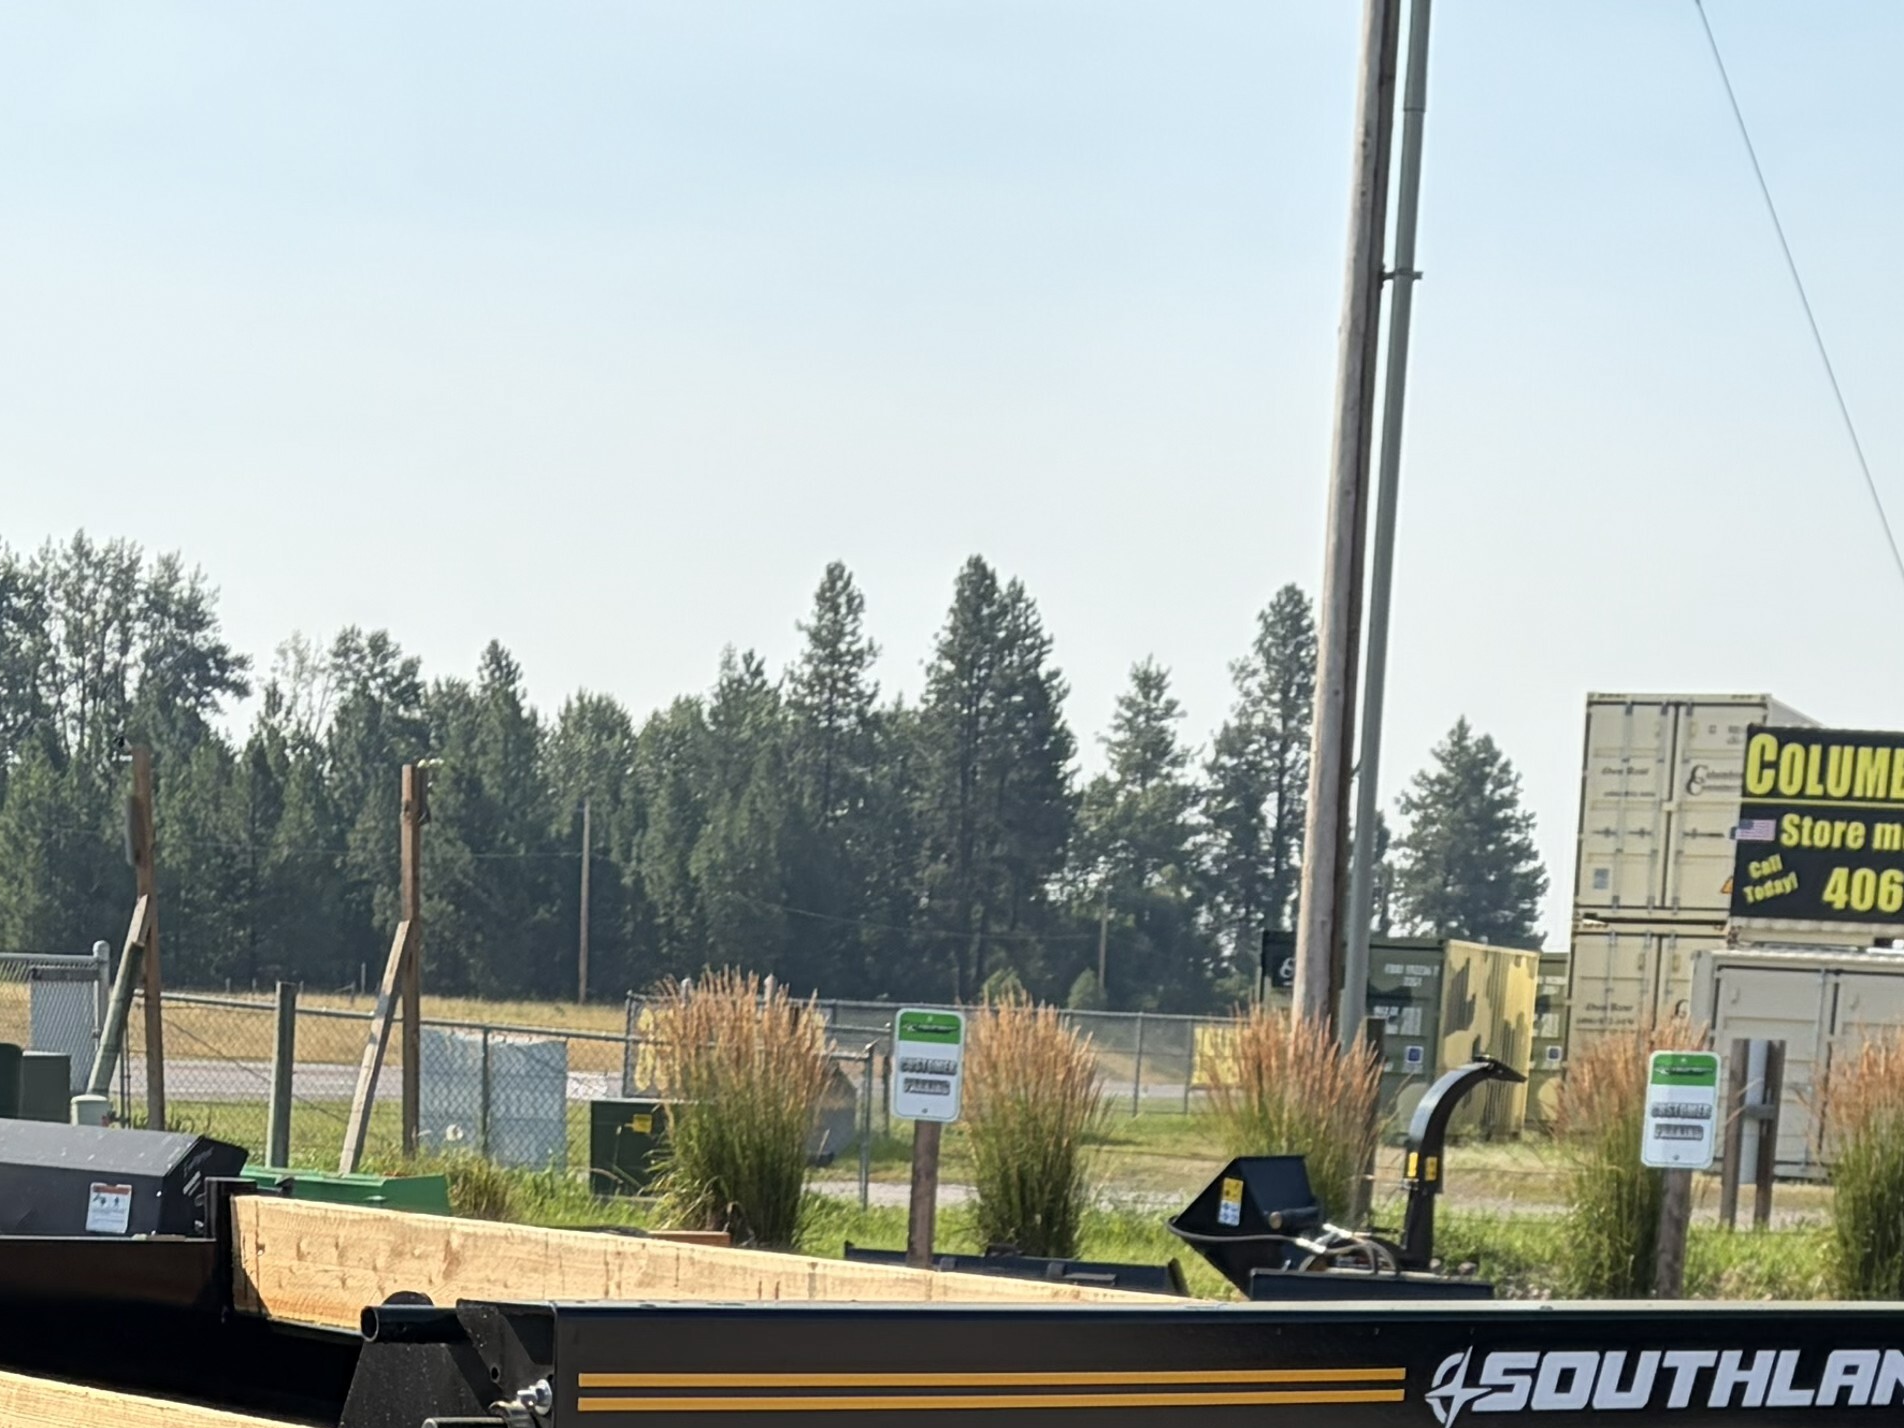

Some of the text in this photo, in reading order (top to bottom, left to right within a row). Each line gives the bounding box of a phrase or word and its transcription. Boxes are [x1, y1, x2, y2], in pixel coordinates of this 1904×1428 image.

[1780, 813, 1866, 850] Store
[1748, 853, 1784, 879] Call
[1742, 871, 1799, 904] Today!
